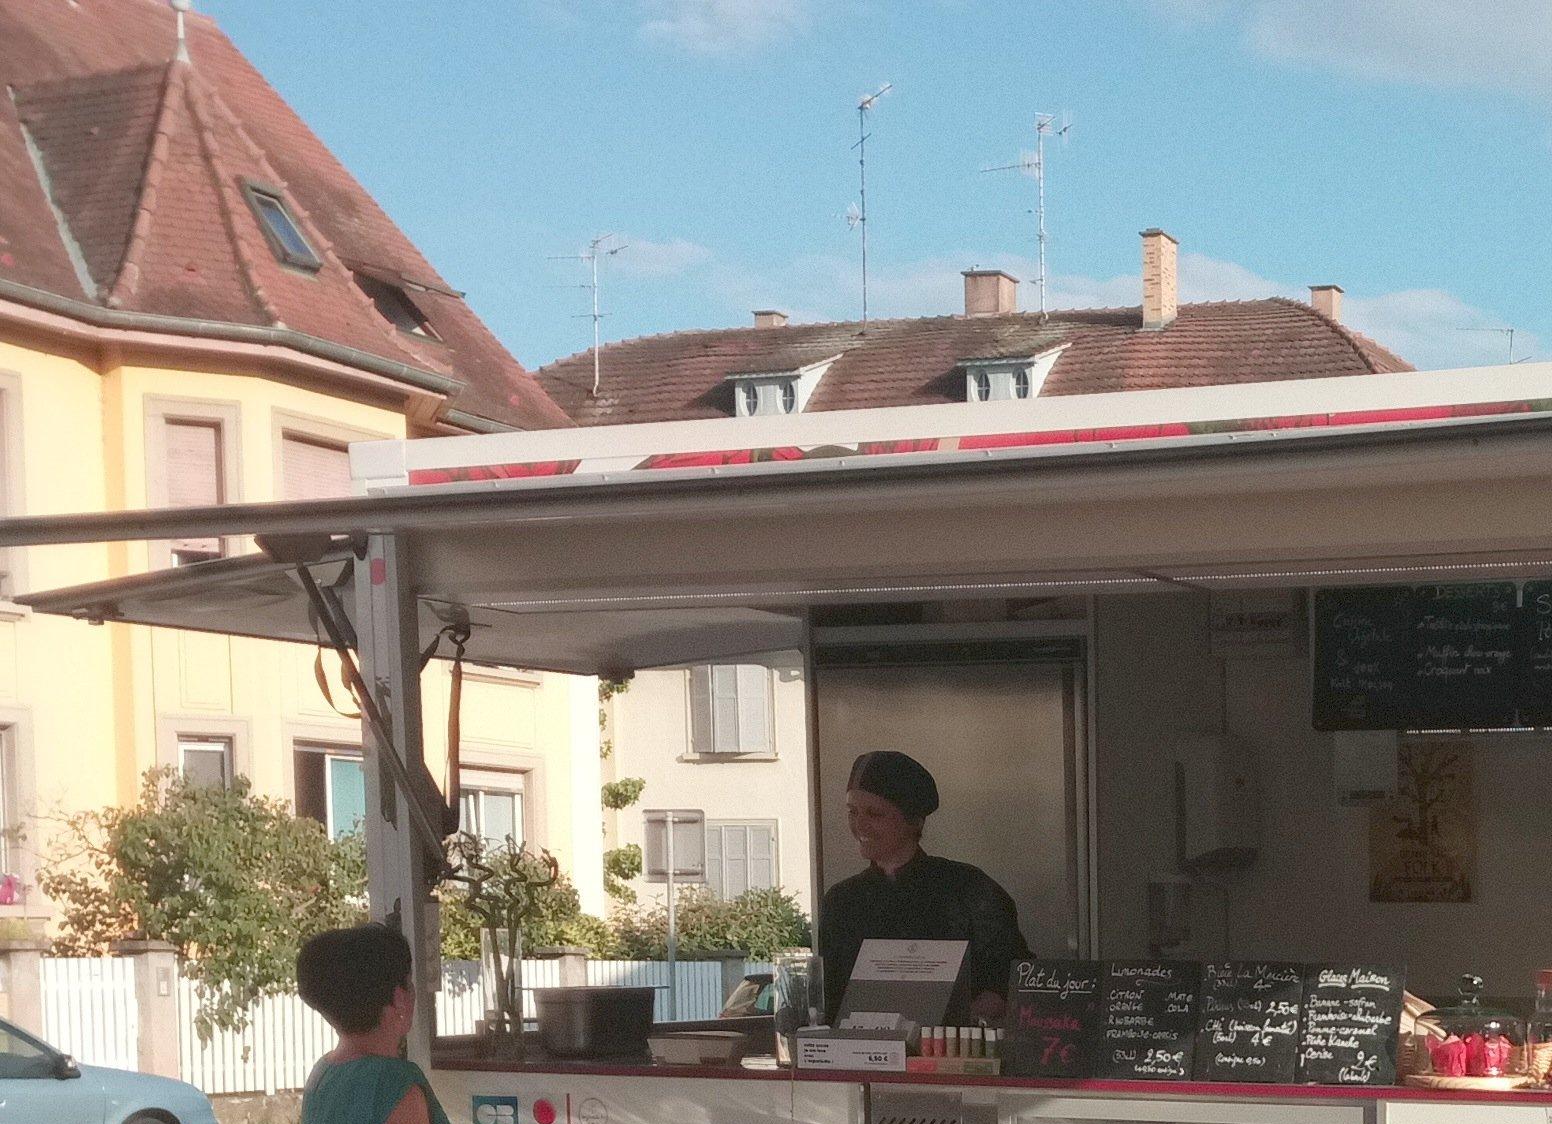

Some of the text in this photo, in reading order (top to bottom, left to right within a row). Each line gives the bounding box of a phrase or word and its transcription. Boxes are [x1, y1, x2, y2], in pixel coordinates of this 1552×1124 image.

[1017, 962, 1046, 987] Plat
[1047, 969, 1061, 989] du
[1111, 963, 1172, 978] Limonades
[1348, 968, 1391, 985] Maison
